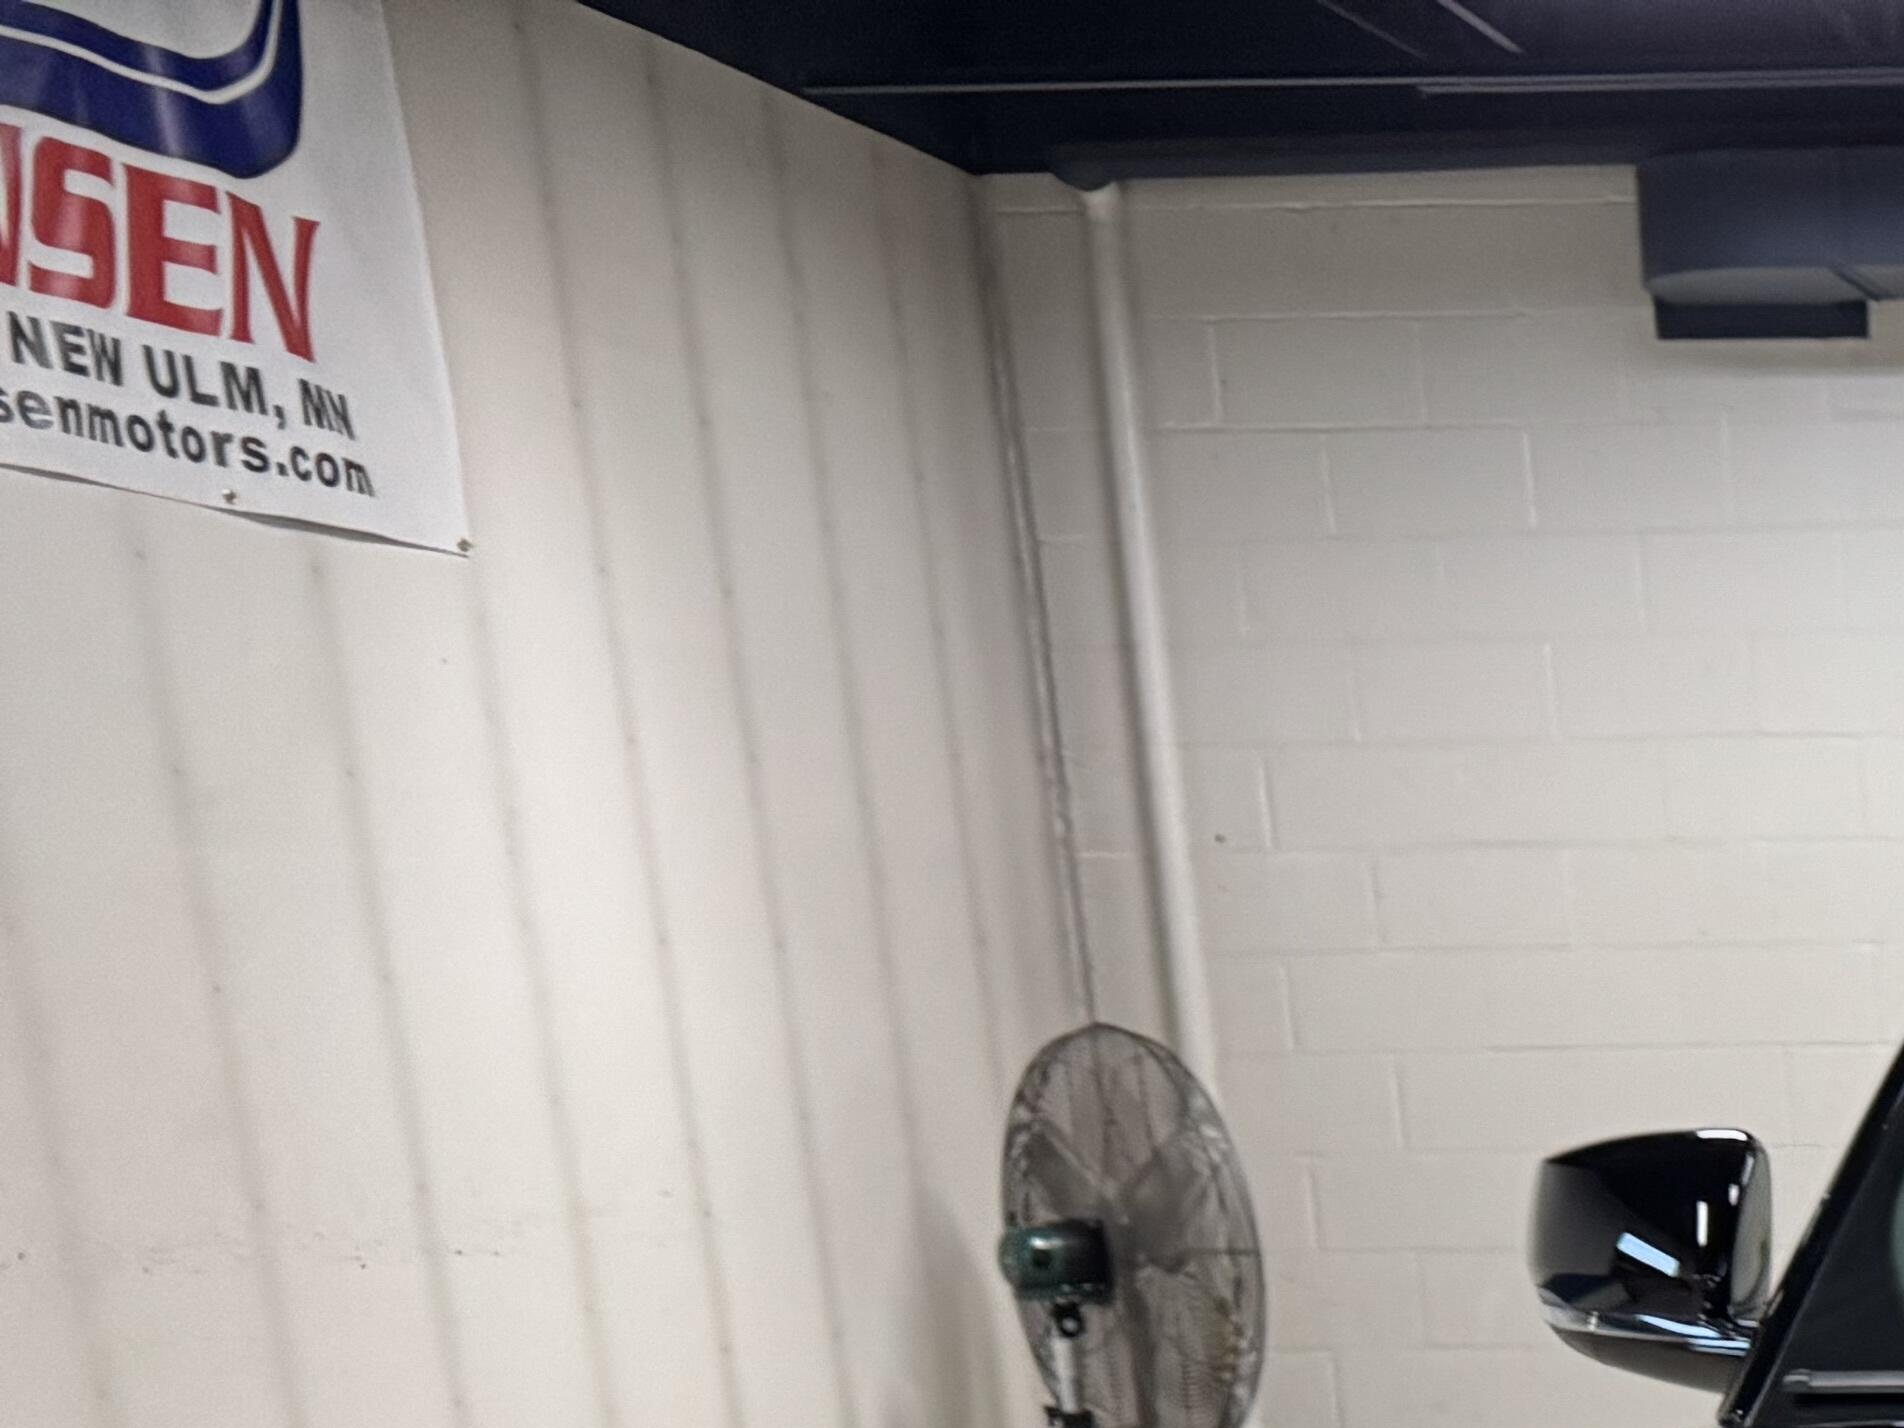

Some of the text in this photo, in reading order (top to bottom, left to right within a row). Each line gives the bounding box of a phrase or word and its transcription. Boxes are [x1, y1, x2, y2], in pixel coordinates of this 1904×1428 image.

[7, 310, 356, 440] NEW ULM, MN
